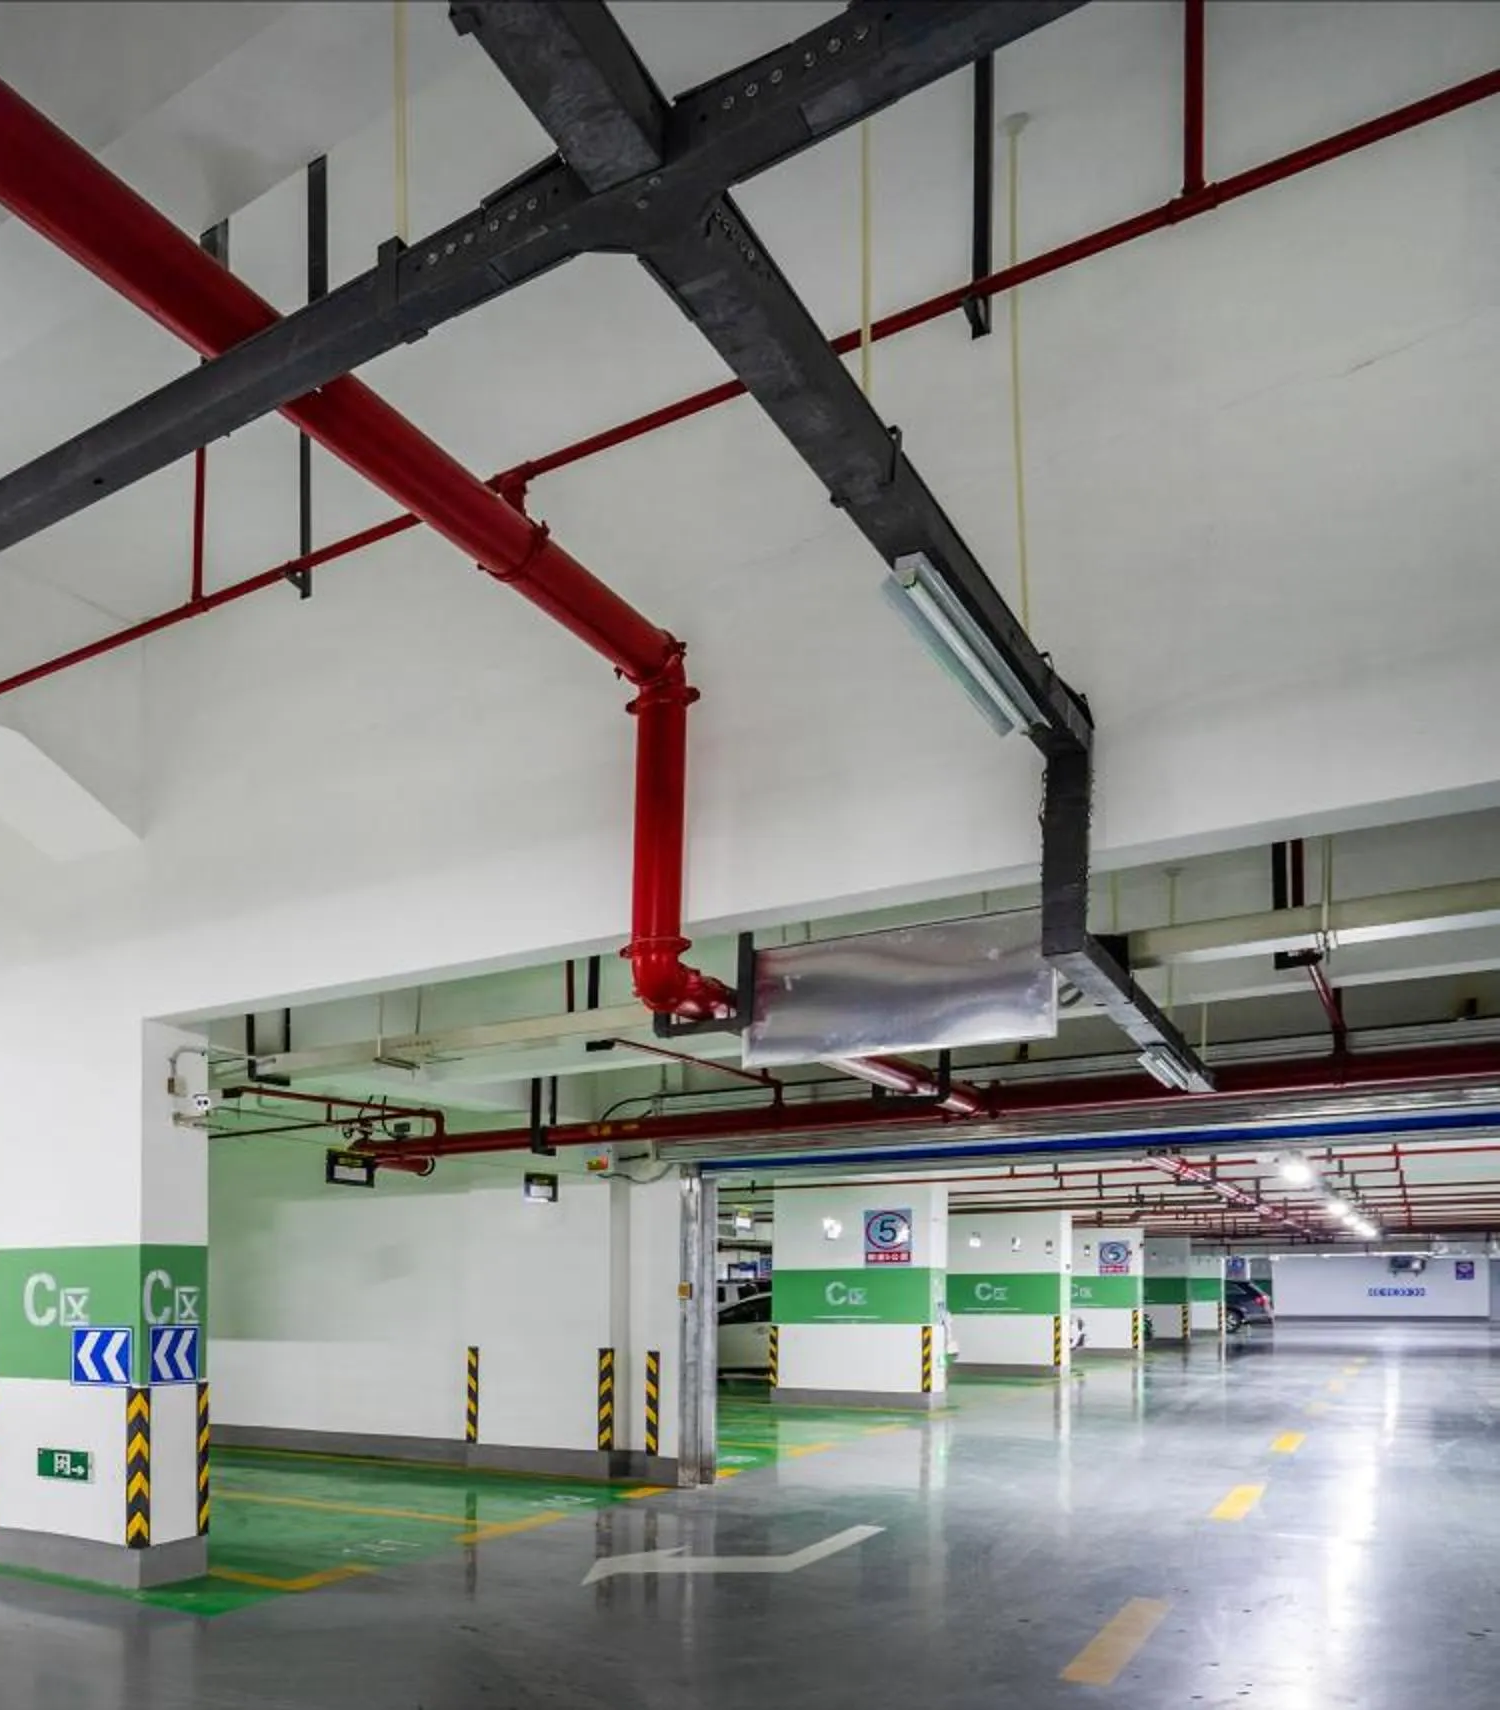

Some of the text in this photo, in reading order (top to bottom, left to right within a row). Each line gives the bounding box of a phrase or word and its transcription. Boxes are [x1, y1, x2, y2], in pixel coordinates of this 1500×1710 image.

[878, 1219, 898, 1243] 5
[23, 1271, 91, 1328] C区
[143, 1269, 200, 1325] C区
[825, 1281, 868, 1306] C区
